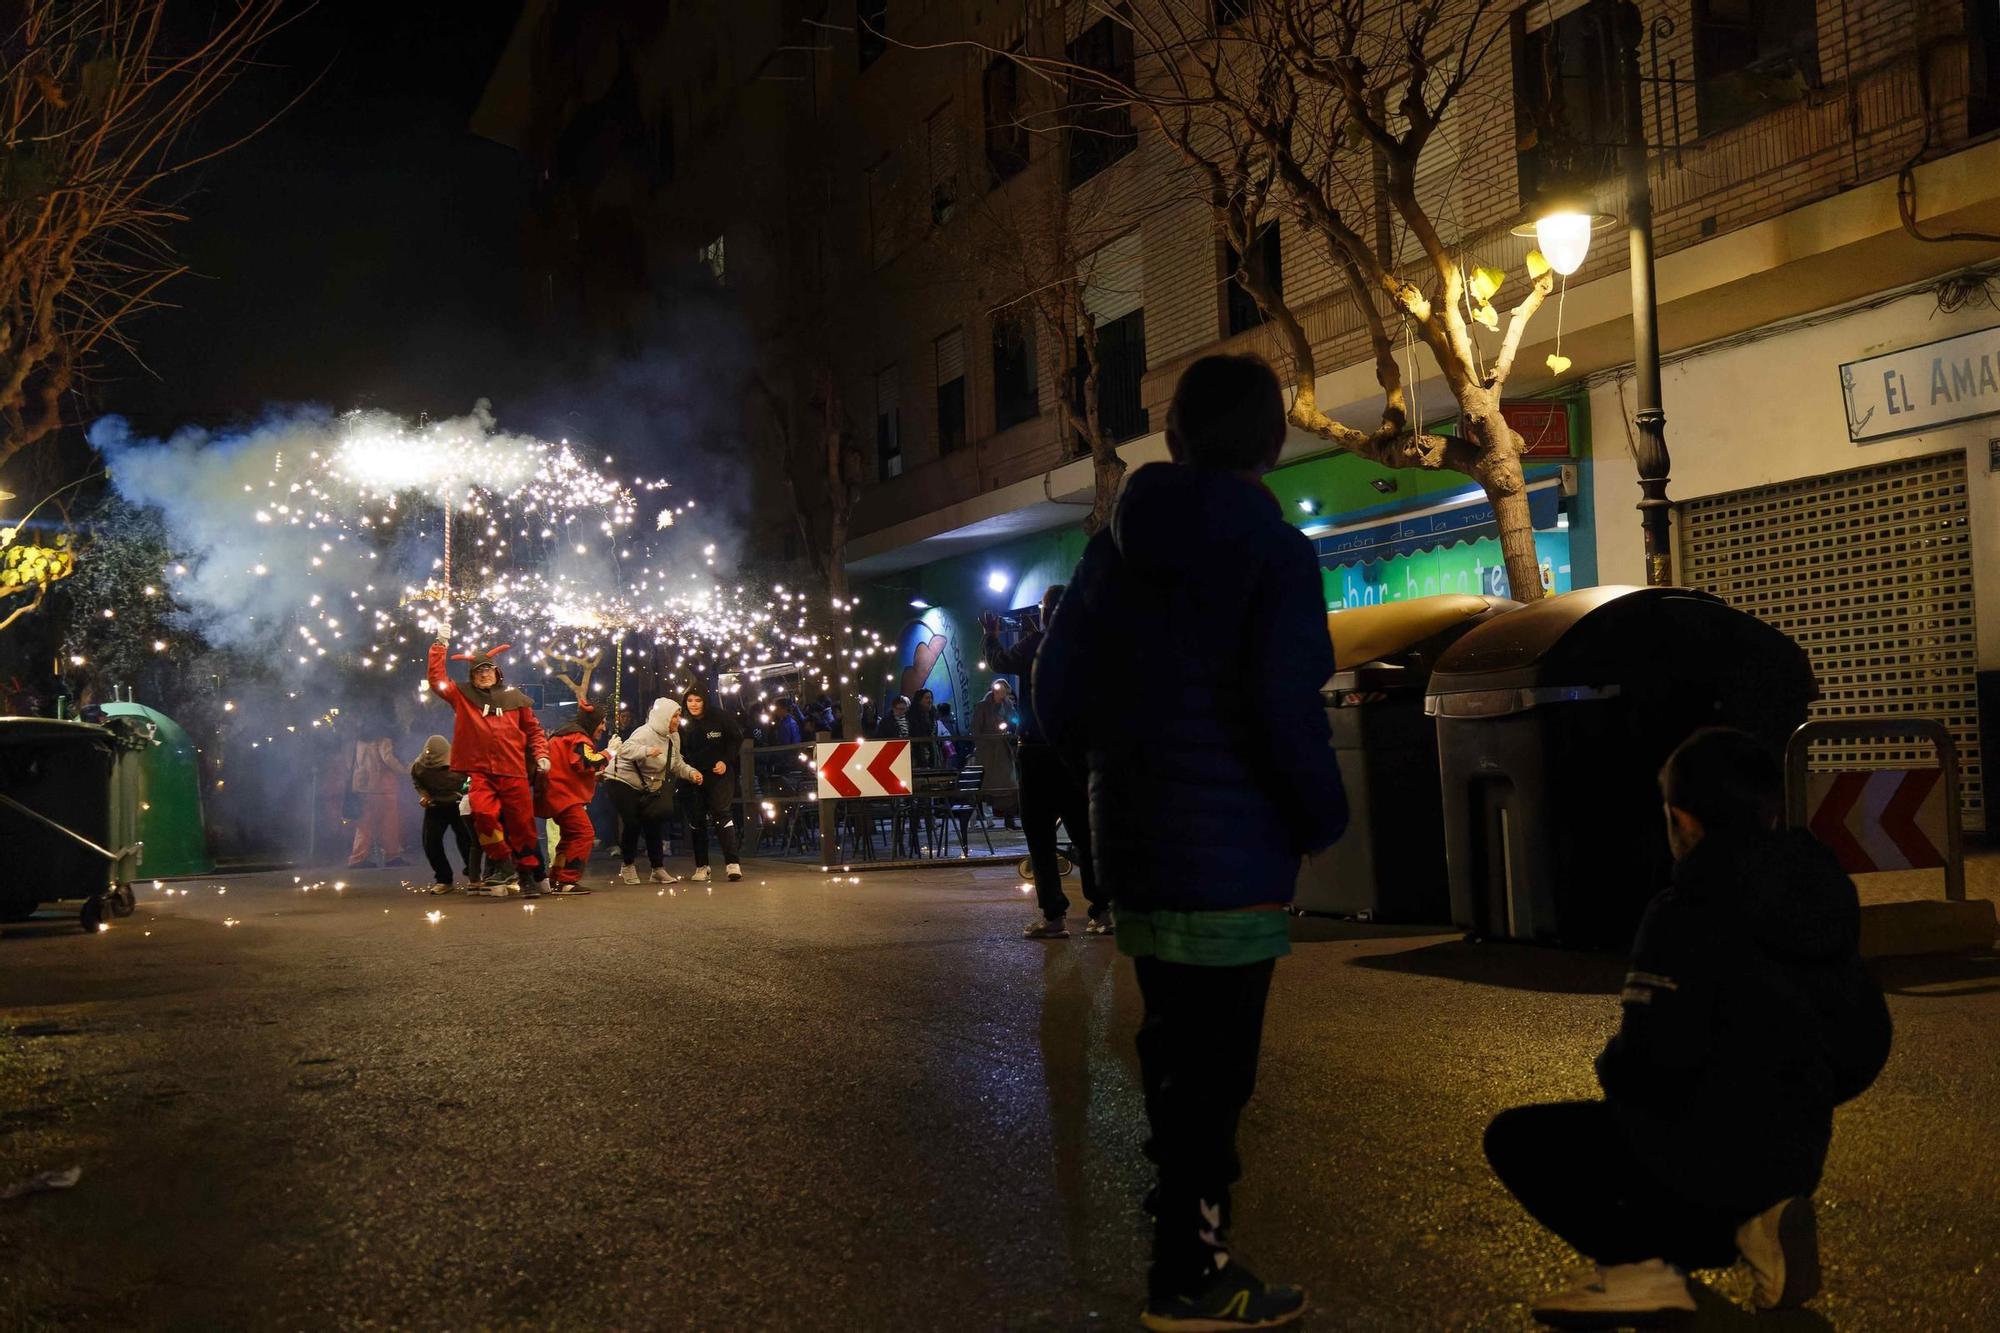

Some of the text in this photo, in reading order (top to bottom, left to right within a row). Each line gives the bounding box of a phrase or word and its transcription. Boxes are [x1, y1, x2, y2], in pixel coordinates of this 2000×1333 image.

[1883, 350, 2000, 415] EL AMA
[1390, 521, 1416, 542] de
[1429, 515, 1447, 533] la
